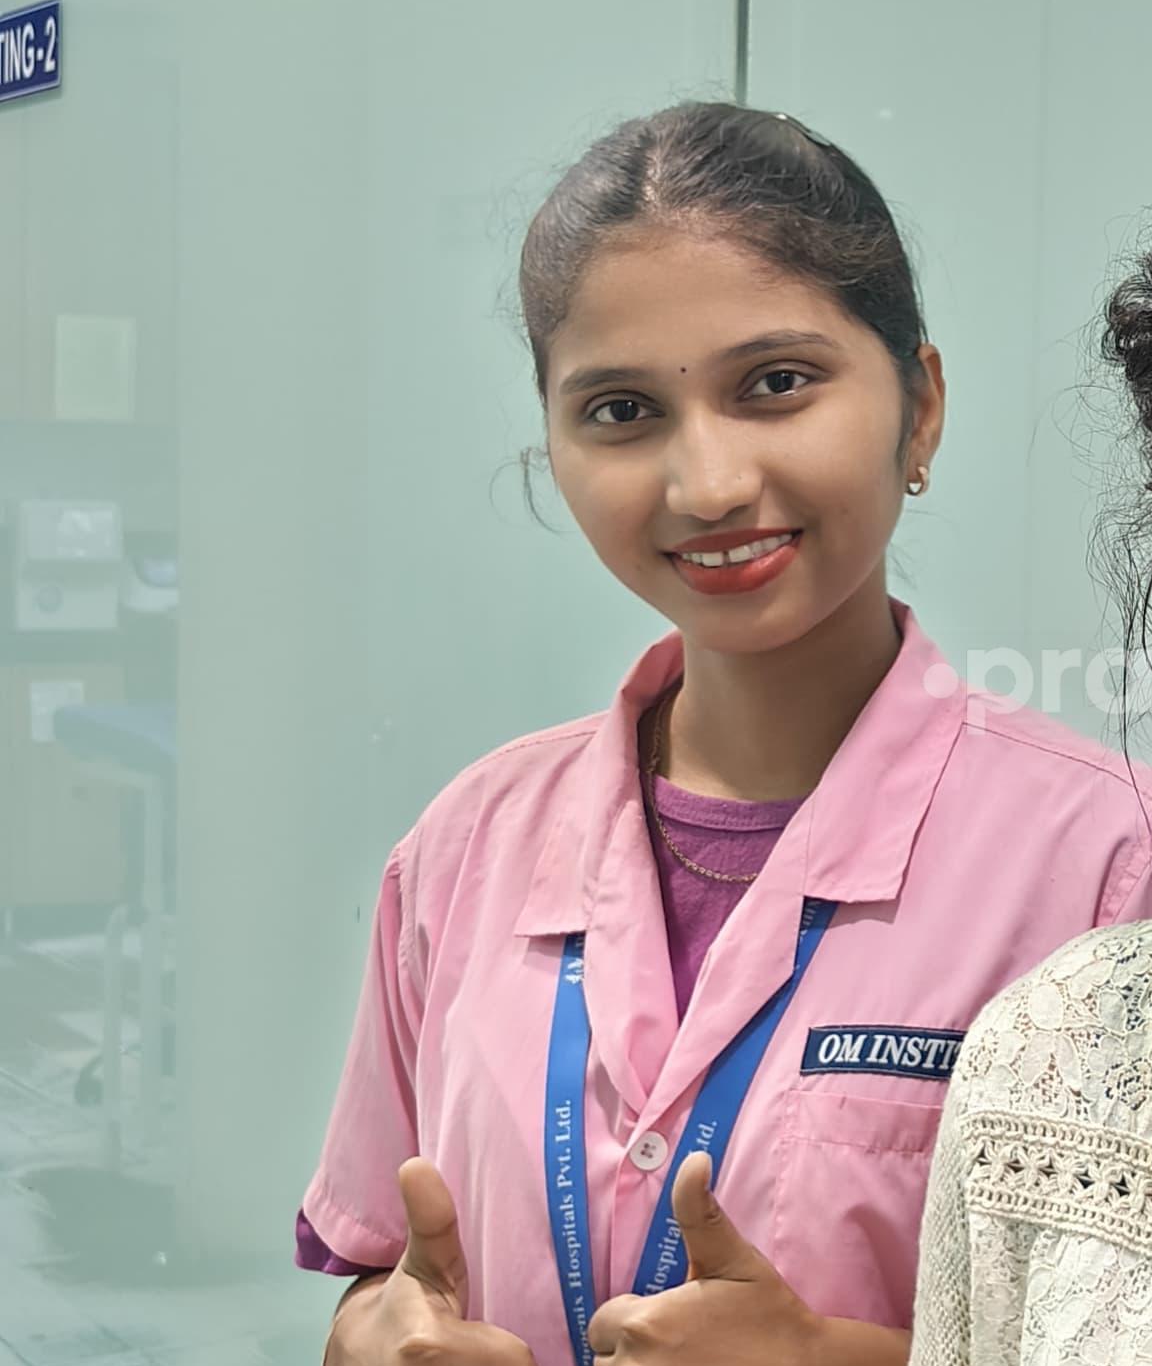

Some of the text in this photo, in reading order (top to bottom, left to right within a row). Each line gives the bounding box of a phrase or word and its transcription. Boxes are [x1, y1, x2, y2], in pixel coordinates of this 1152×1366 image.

[818, 1034, 866, 1063] OM
[555, 1099, 571, 1142] Ltd.
[691, 1121, 717, 1153] td.
[557, 1148, 573, 1188] Pvt.
[559, 1194, 582, 1288] Hospitals
[643, 1217, 681, 1296] Hospital
